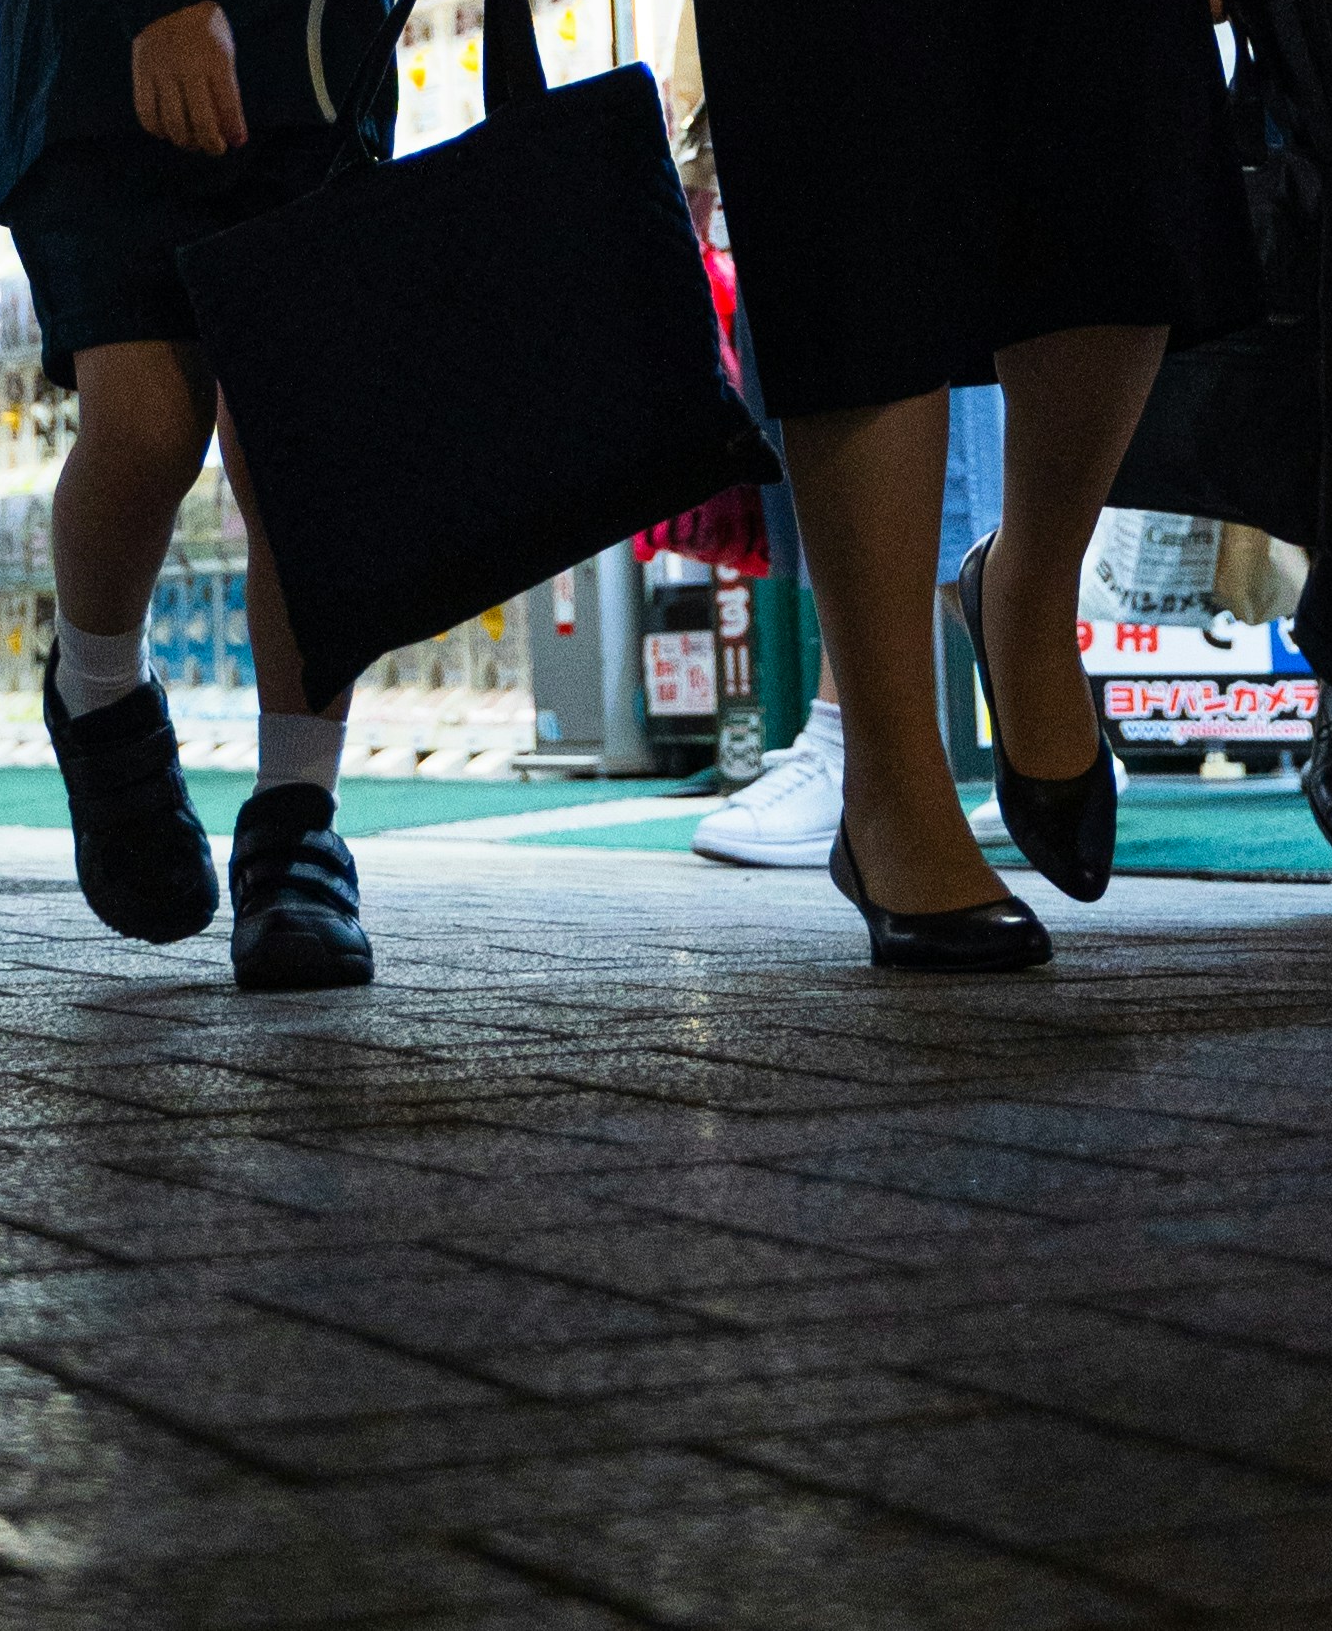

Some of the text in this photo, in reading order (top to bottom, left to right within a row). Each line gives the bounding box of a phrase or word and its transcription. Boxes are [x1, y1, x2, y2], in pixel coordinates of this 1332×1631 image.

[1104, 680, 1319, 720] ヨドバシカメラ
